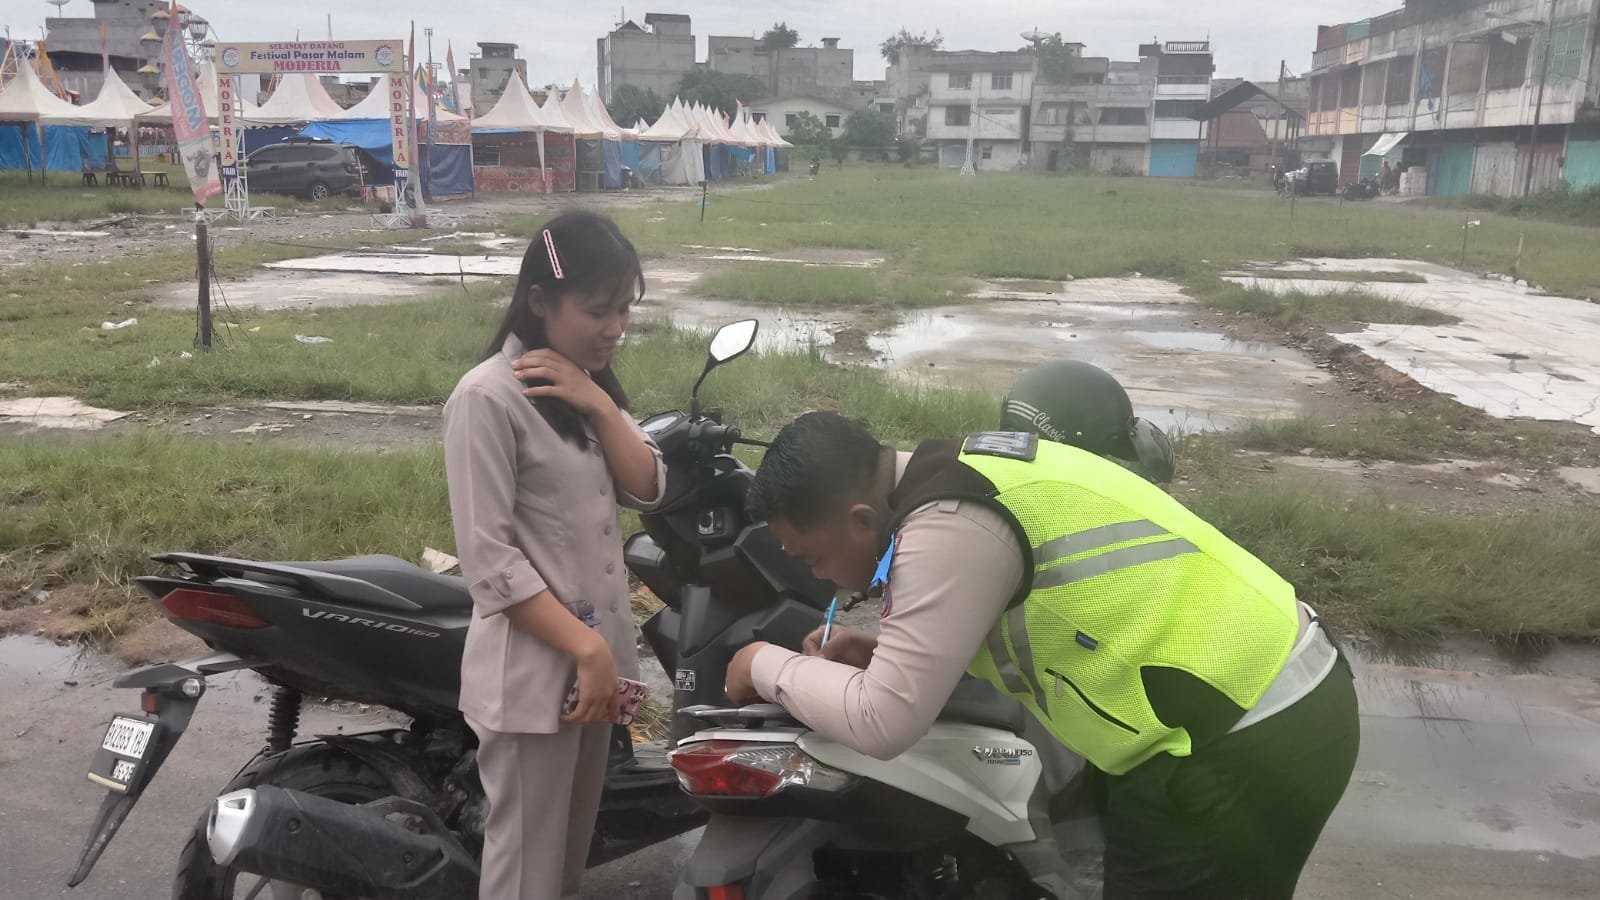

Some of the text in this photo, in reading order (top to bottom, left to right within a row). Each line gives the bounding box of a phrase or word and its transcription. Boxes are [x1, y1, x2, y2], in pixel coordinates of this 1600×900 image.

[251, 50, 365, 60] Festival Pasar Malam
[273, 60, 341, 71] MODERIA
[219, 79, 233, 160] MODERIA
[391, 78, 406, 162] MODERIA
[1032, 412, 1065, 442] Classic
